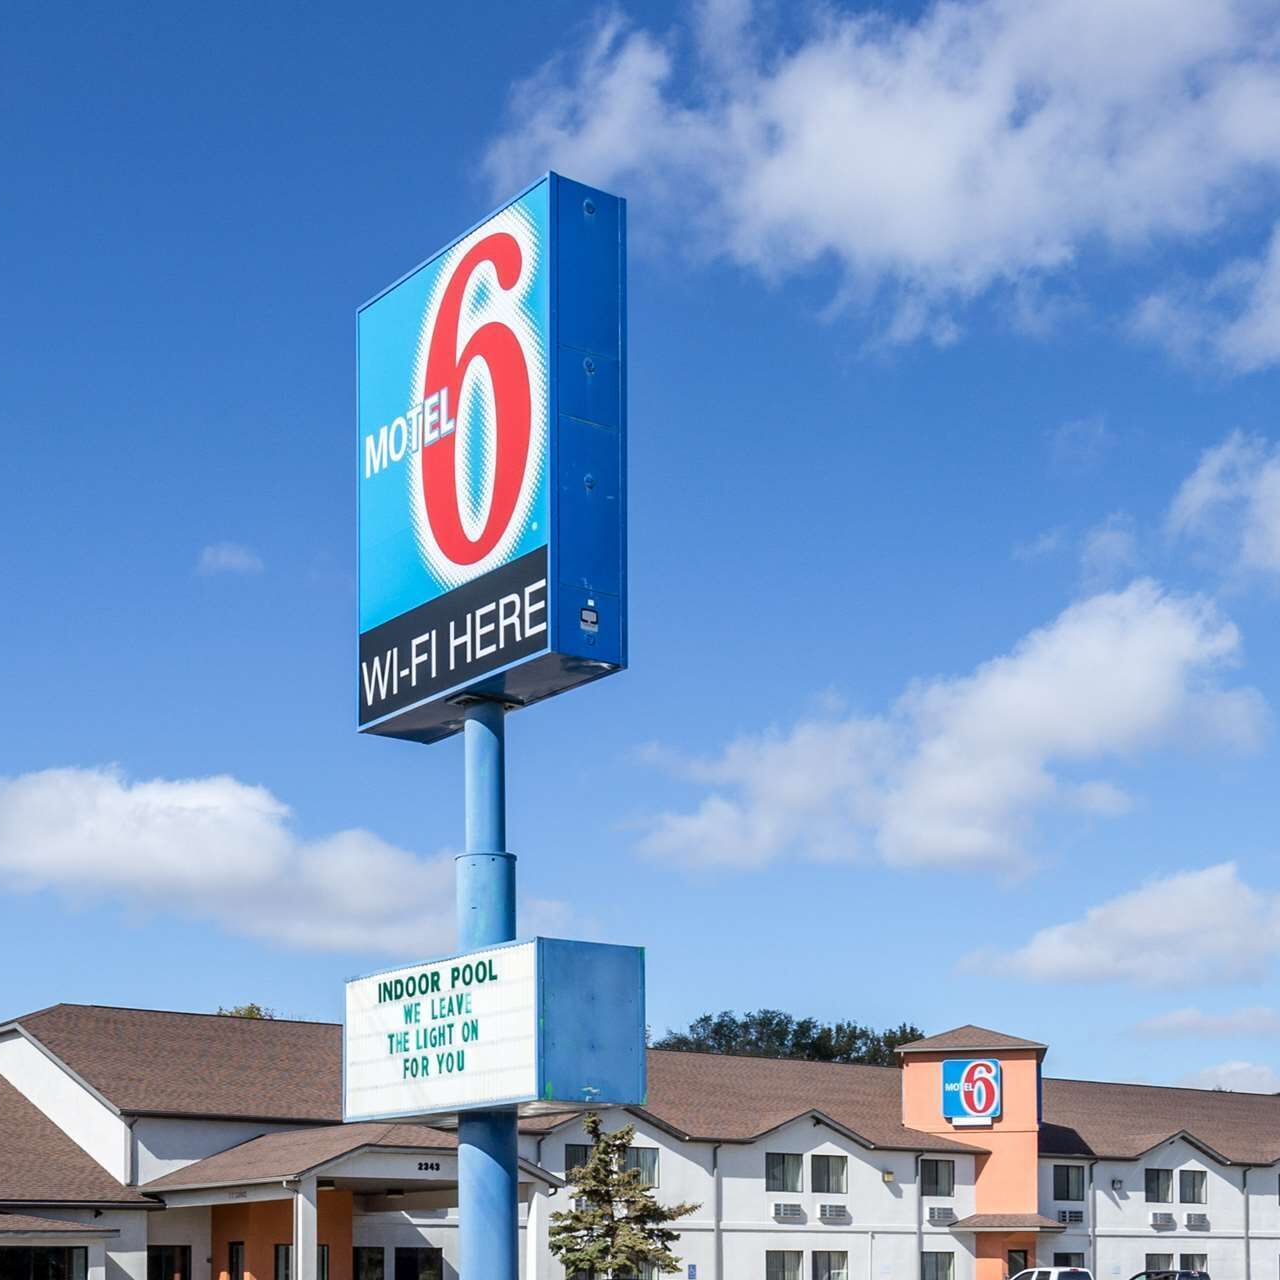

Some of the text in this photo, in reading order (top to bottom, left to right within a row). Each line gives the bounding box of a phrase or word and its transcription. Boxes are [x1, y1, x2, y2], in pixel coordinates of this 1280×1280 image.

[364, 231, 531, 565] MOTEL 6
[361, 578, 547, 706] WI-FI HERE
[378, 959, 498, 1004] INDOOR POOL
[403, 991, 472, 1024] WE LEAVE
[387, 1019, 479, 1055] THE LIGHT ON
[403, 1050, 465, 1079] FOR YOU
[945, 1062, 996, 1114] MOEL 6
